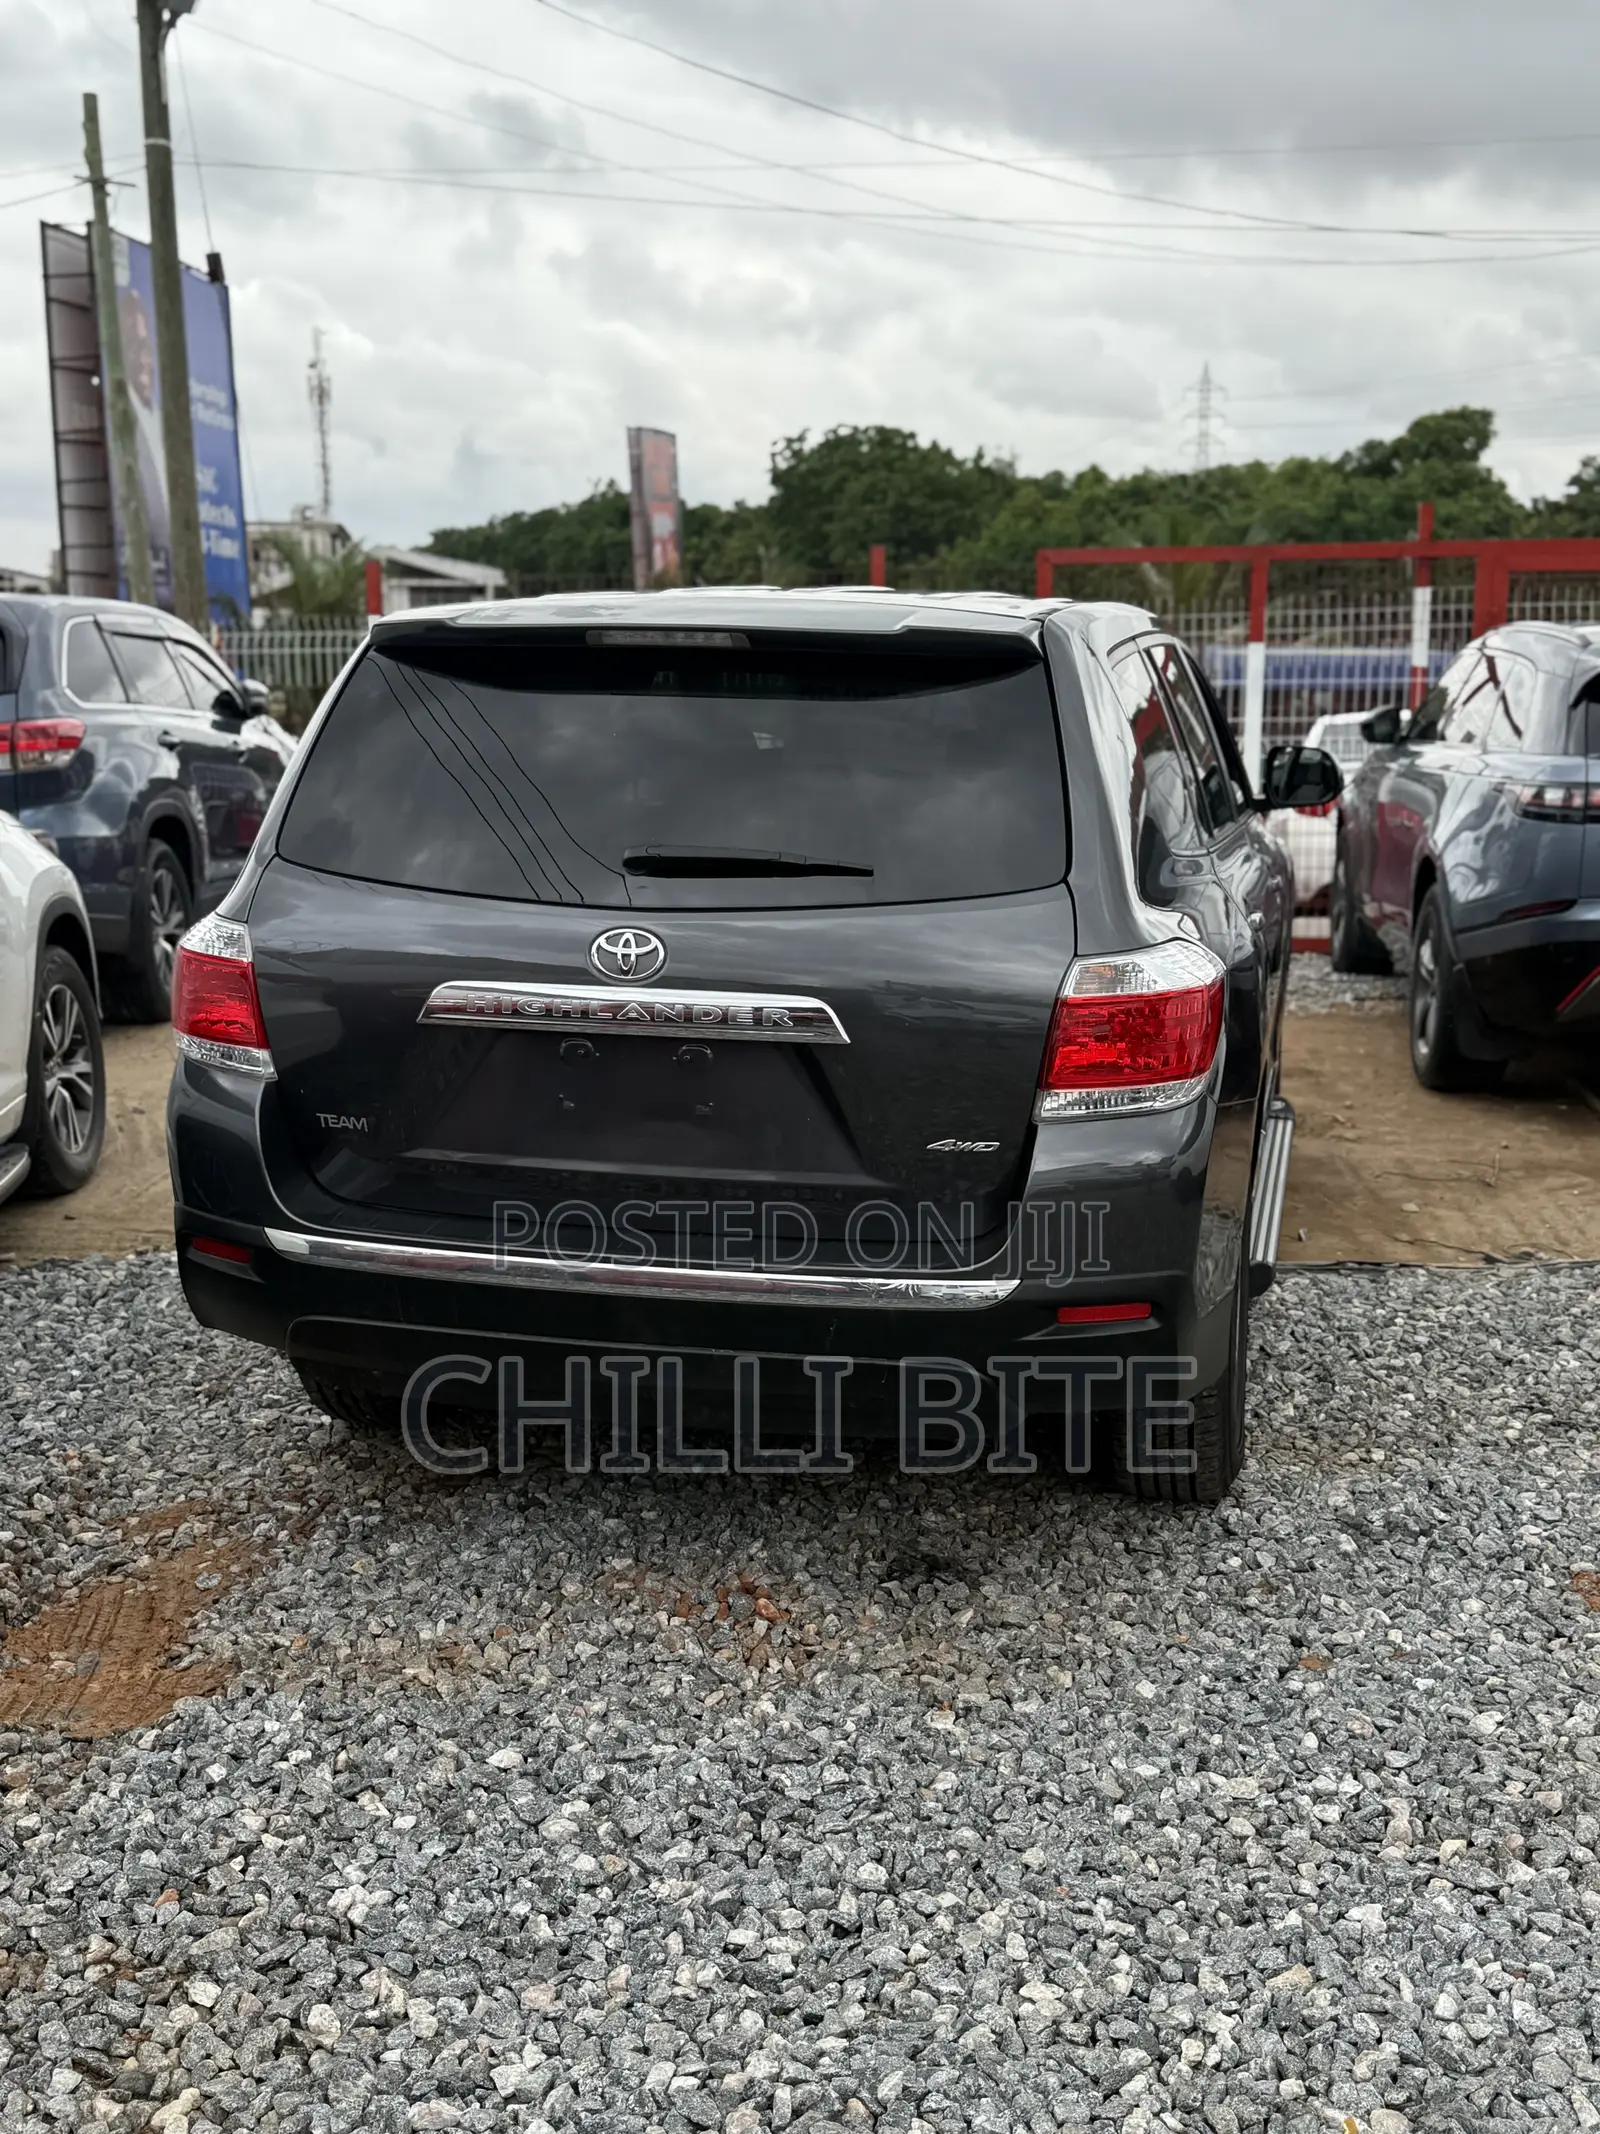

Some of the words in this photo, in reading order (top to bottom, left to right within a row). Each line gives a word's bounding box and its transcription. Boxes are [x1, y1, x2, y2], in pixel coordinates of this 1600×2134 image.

[466, 994, 794, 1027] HIGHLANDER
[316, 1112, 368, 1132] TEAM
[926, 1139, 1000, 1151] 4WD
